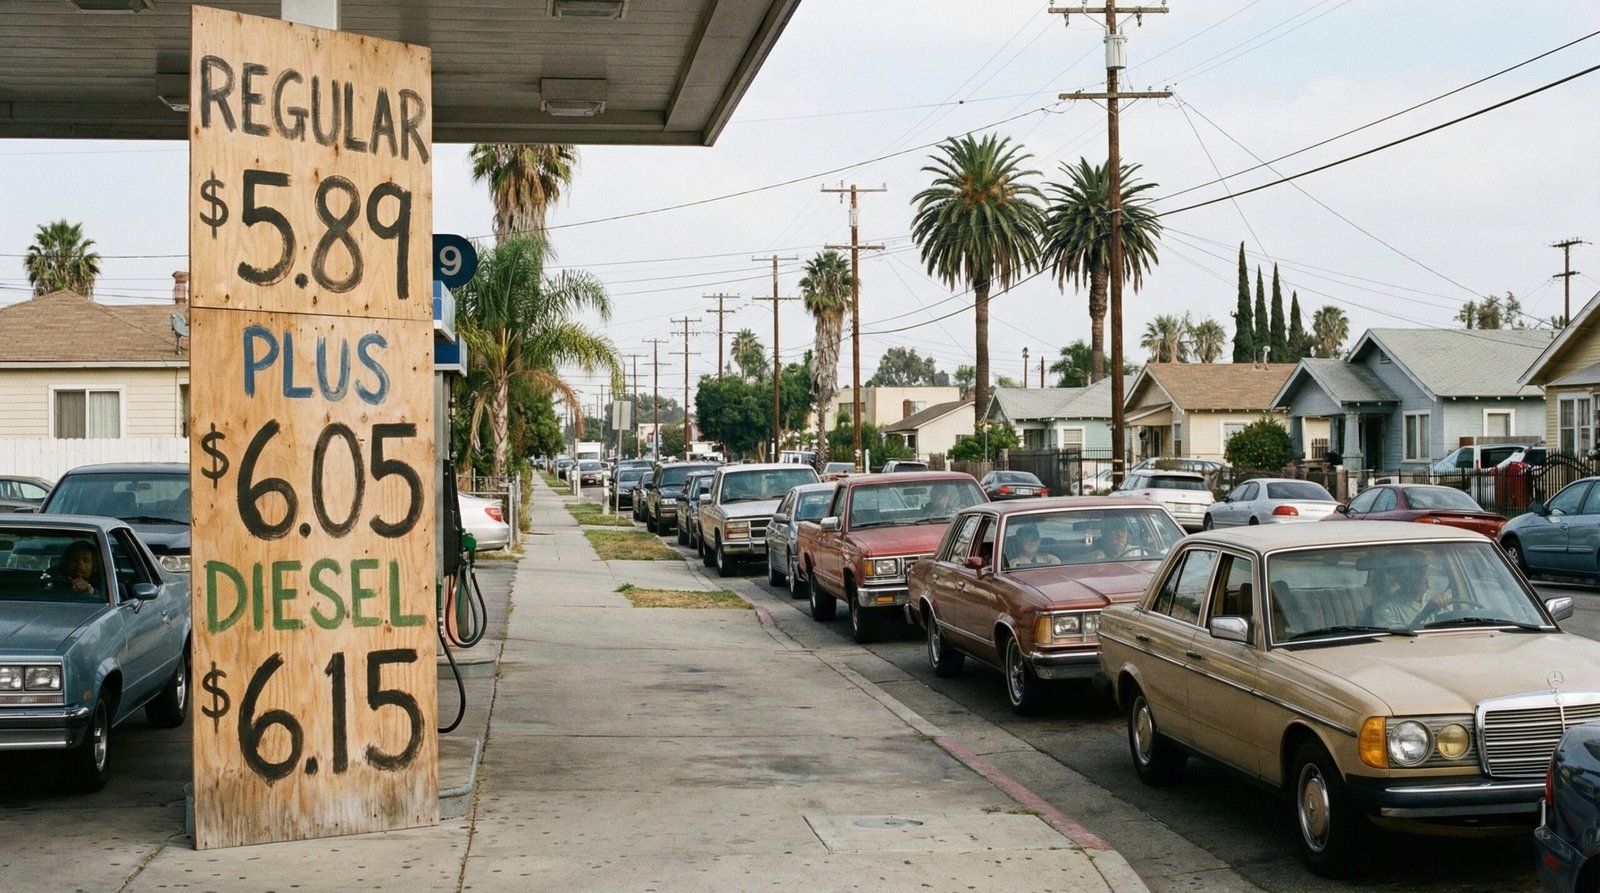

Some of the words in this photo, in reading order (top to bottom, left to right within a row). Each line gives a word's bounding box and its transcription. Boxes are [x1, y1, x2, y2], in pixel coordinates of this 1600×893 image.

[201, 55, 429, 164] REGULAR
[200, 169, 411, 300] $5.89
[440, 246, 462, 276] 9
[243, 325, 391, 405] PLUS
[201, 419, 425, 541] $6.05
[204, 559, 426, 634] DIESEL
[201, 648, 425, 785] $6.15
